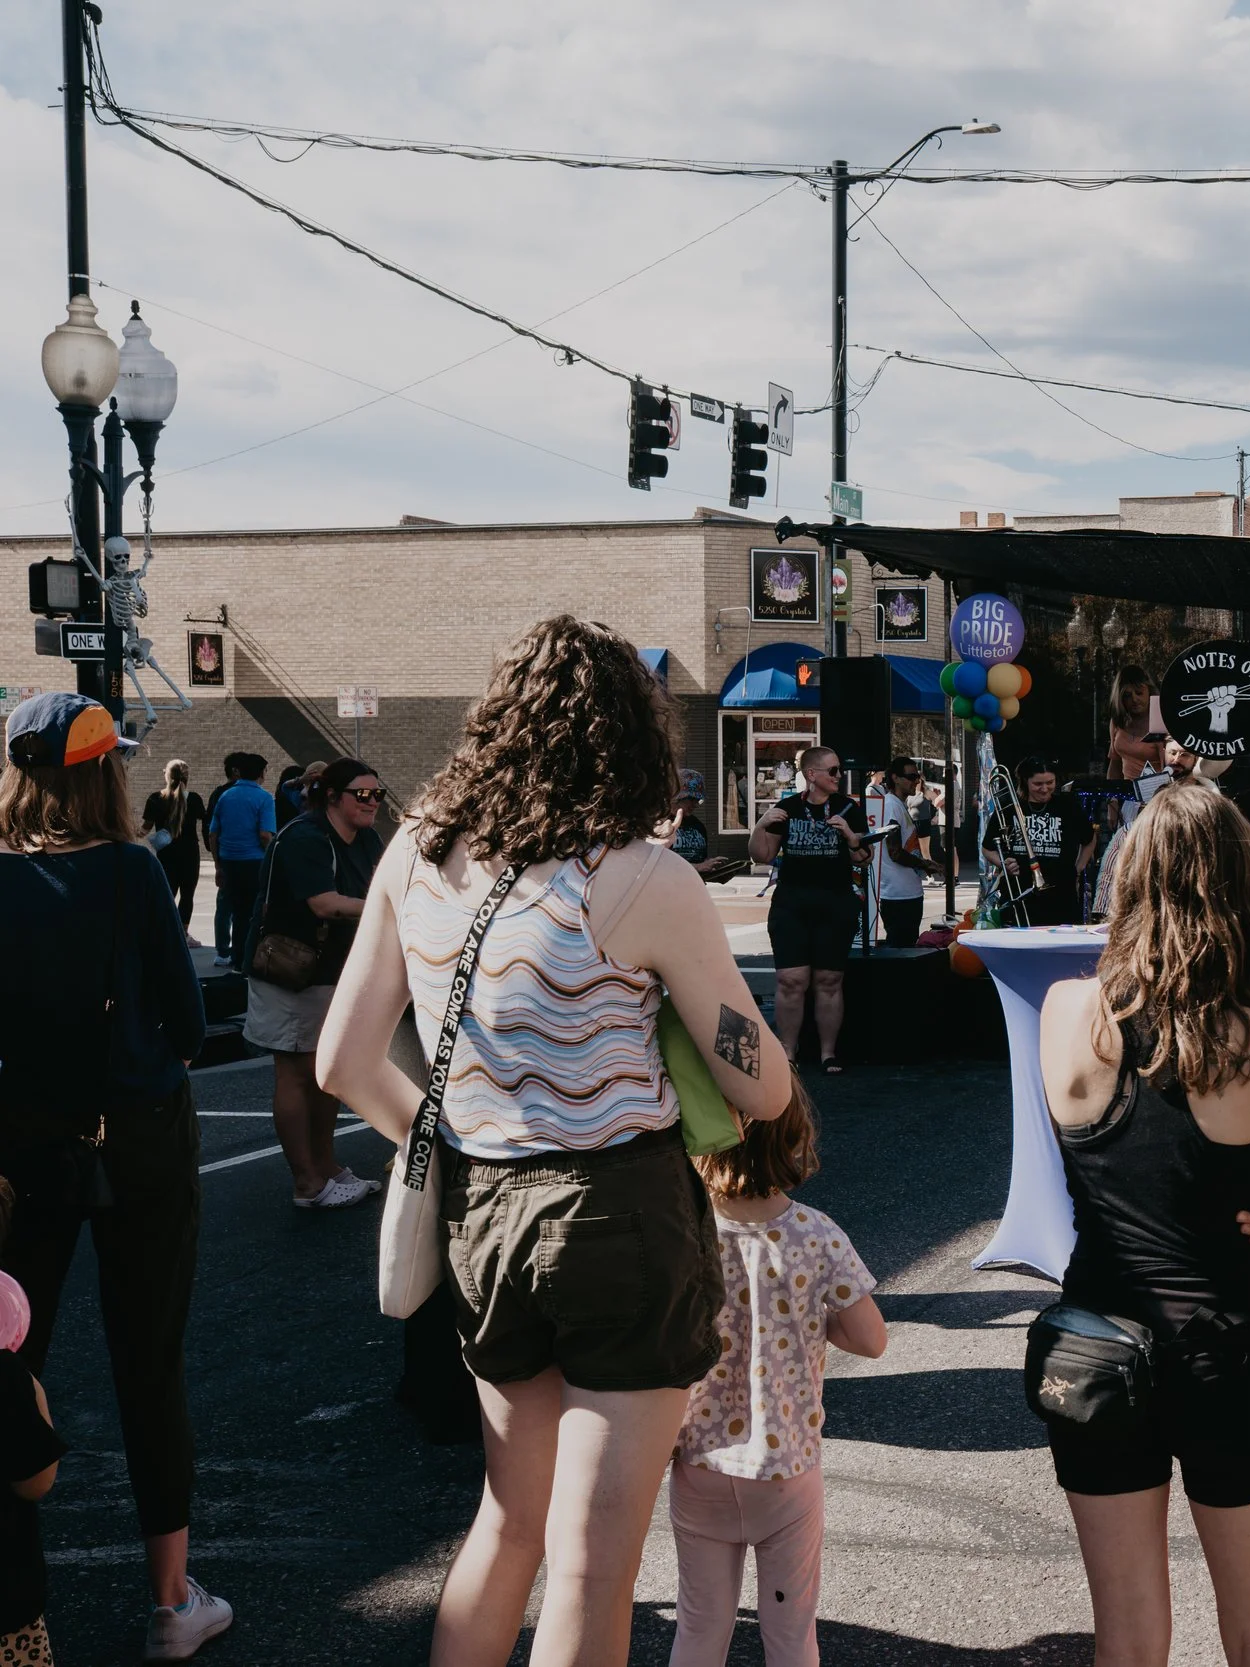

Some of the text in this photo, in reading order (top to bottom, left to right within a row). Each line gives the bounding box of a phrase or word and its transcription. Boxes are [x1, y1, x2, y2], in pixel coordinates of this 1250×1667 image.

[693, 399, 714, 414] ONE WAY
[771, 431, 790, 449] ONLY
[833, 485, 849, 514] Main
[780, 605, 812, 619] Crystals
[971, 599, 1005, 620] BIG
[71, 634, 93, 648] ONE
[960, 620, 1013, 646] PRIDE
[960, 642, 1013, 658] Littleton
[1183, 652, 1236, 674] NOTES
[764, 718, 793, 730] OPEN
[1183, 734, 1246, 756] DISSENT
[407, 865, 516, 1192] AS YOU ARE COME AS YOU ARE COME
